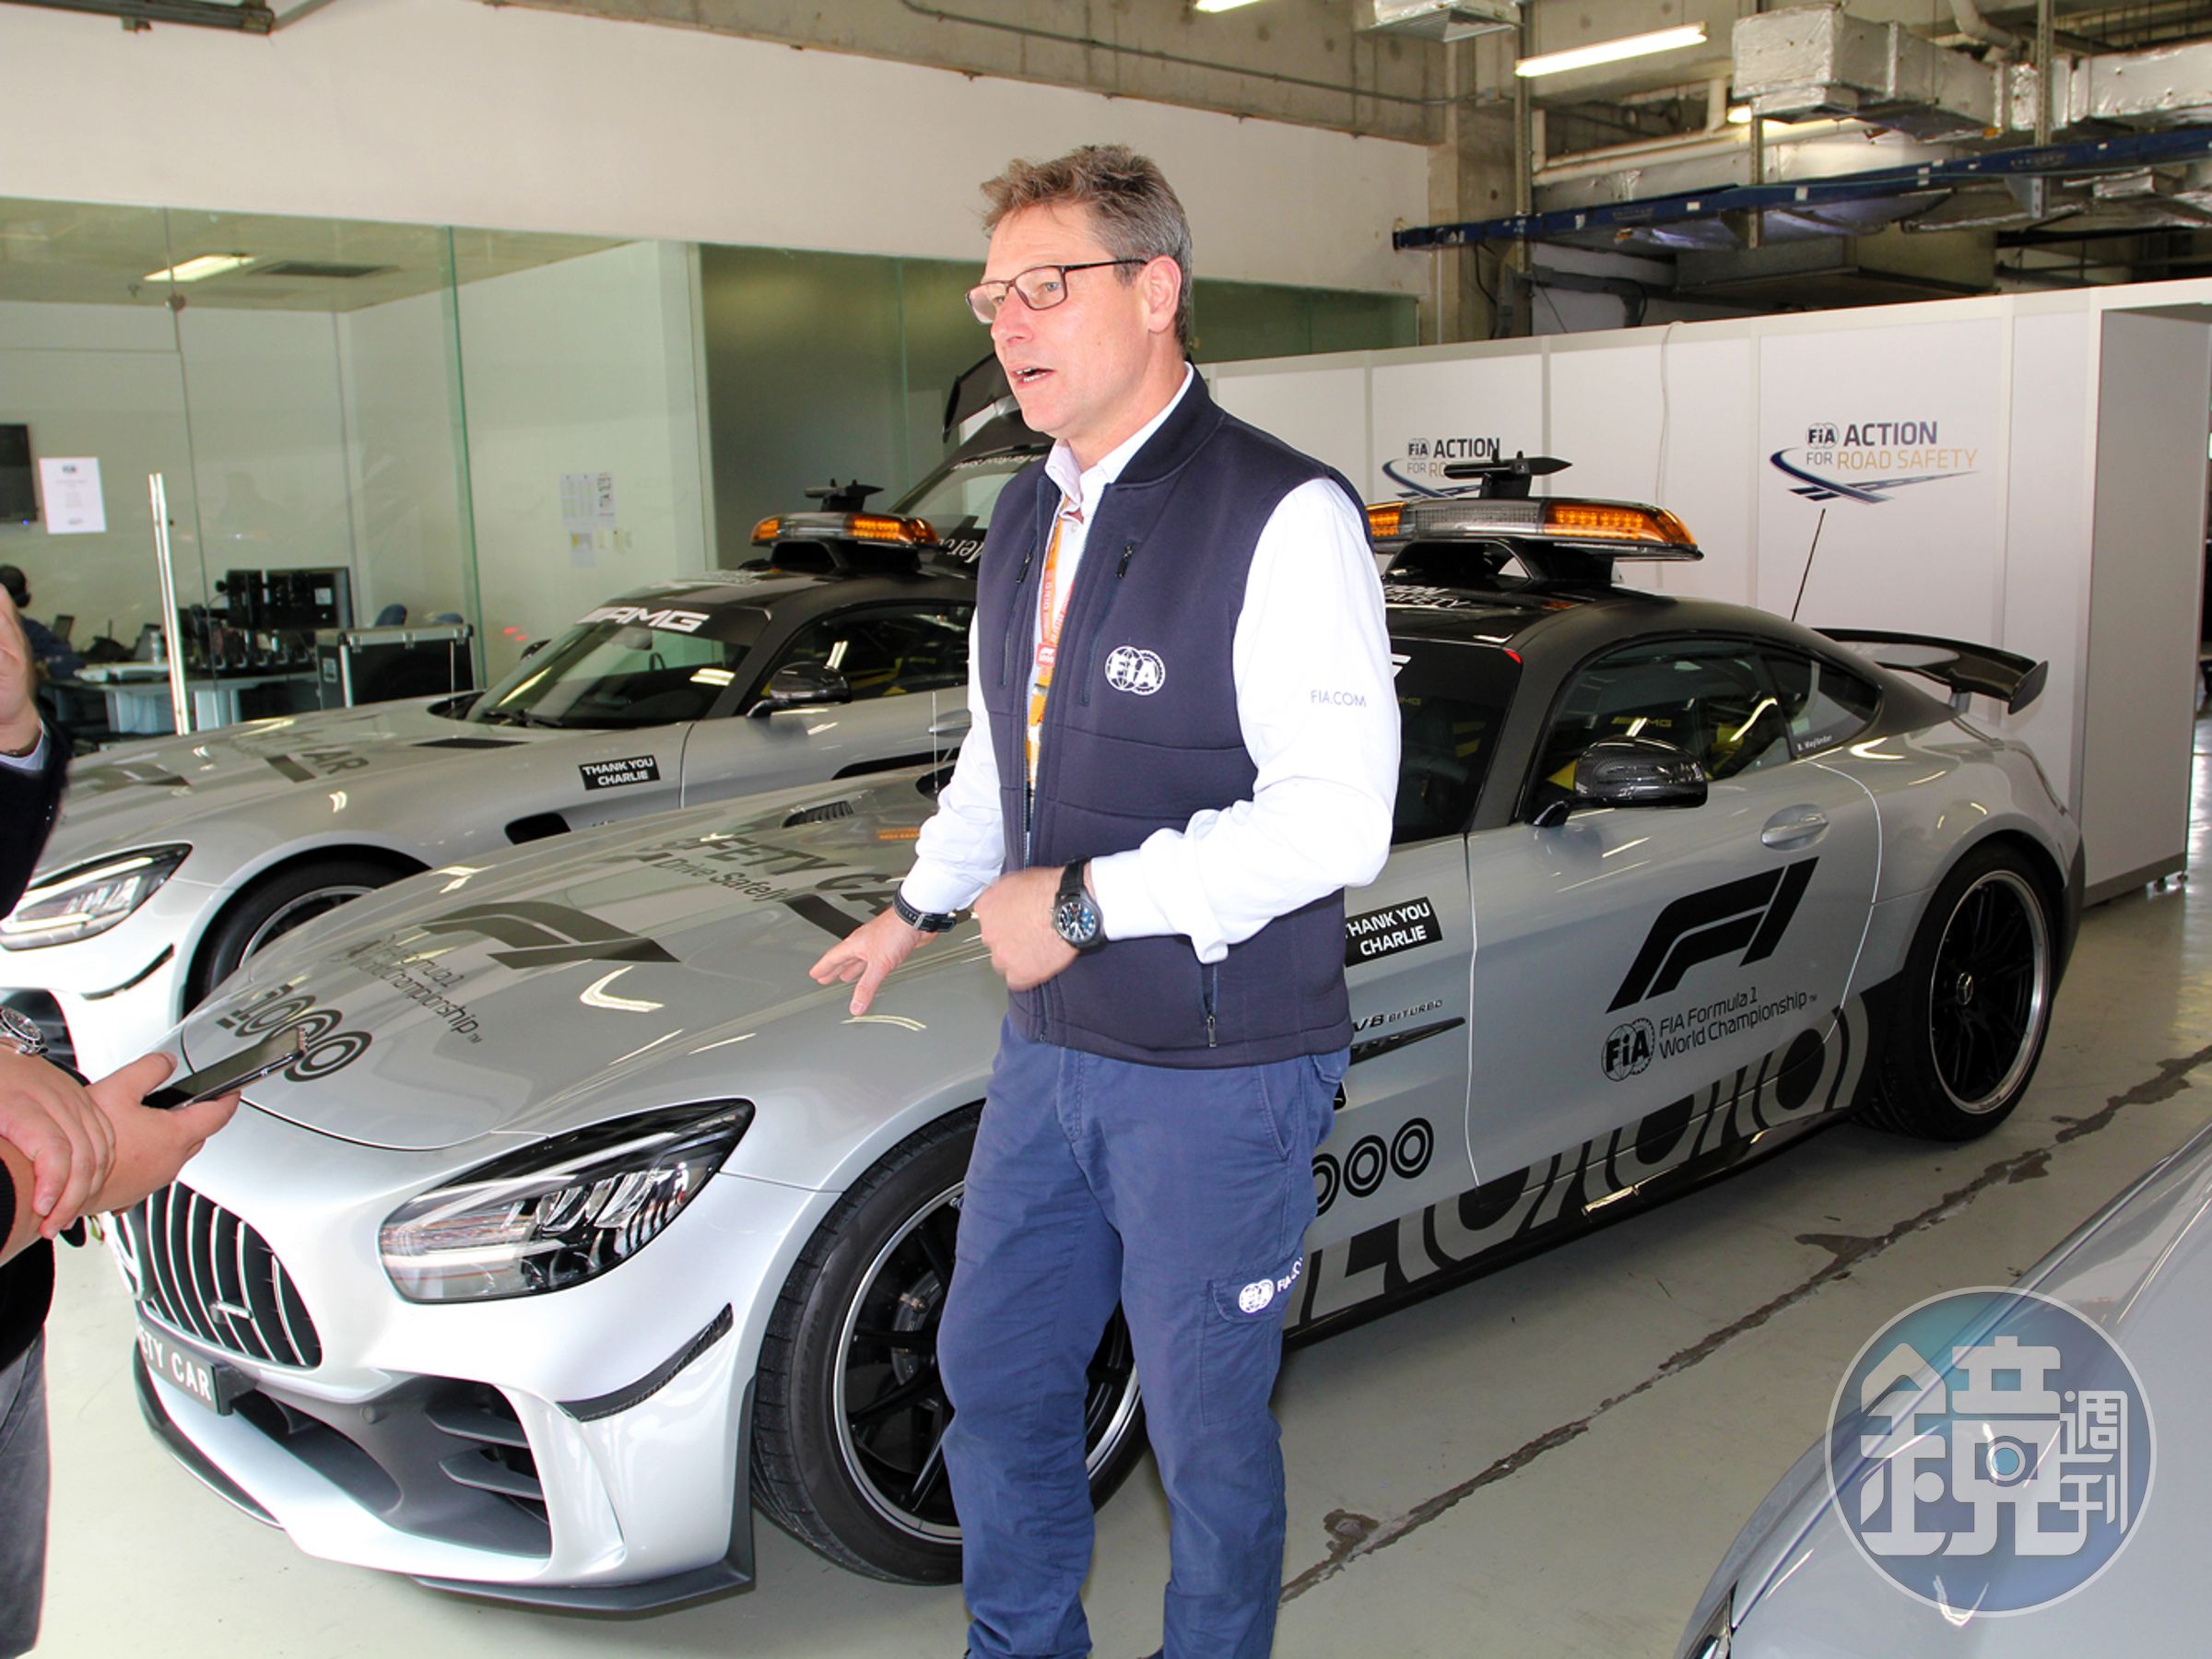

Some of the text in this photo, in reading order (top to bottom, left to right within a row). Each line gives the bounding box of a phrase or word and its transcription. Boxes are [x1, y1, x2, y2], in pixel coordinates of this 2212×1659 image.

[1843, 421, 1937, 447] ACTION
[1433, 438, 1500, 459] ACTION
[1806, 449, 1978, 471] FOR ROAD SAFETY
[1406, 463, 1427, 474] FOR
[594, 606, 711, 633] AMG
[1311, 689, 1367, 708] FIA.COM
[582, 758, 654, 777] THANK YOU
[597, 769, 649, 787] CHARLIE
[653, 856, 717, 878] Drive
[815, 872, 911, 917] CA
[1346, 902, 1430, 939] HANK YOU
[1359, 924, 1429, 956] CHARLIE
[1606, 855, 1820, 1015] F1
[1388, 999, 1443, 1023] BITURBO
[1659, 986, 1759, 1037] FIA Formula 1
[1659, 1030, 1707, 1059] World
[171, 1351, 212, 1402] CAR
